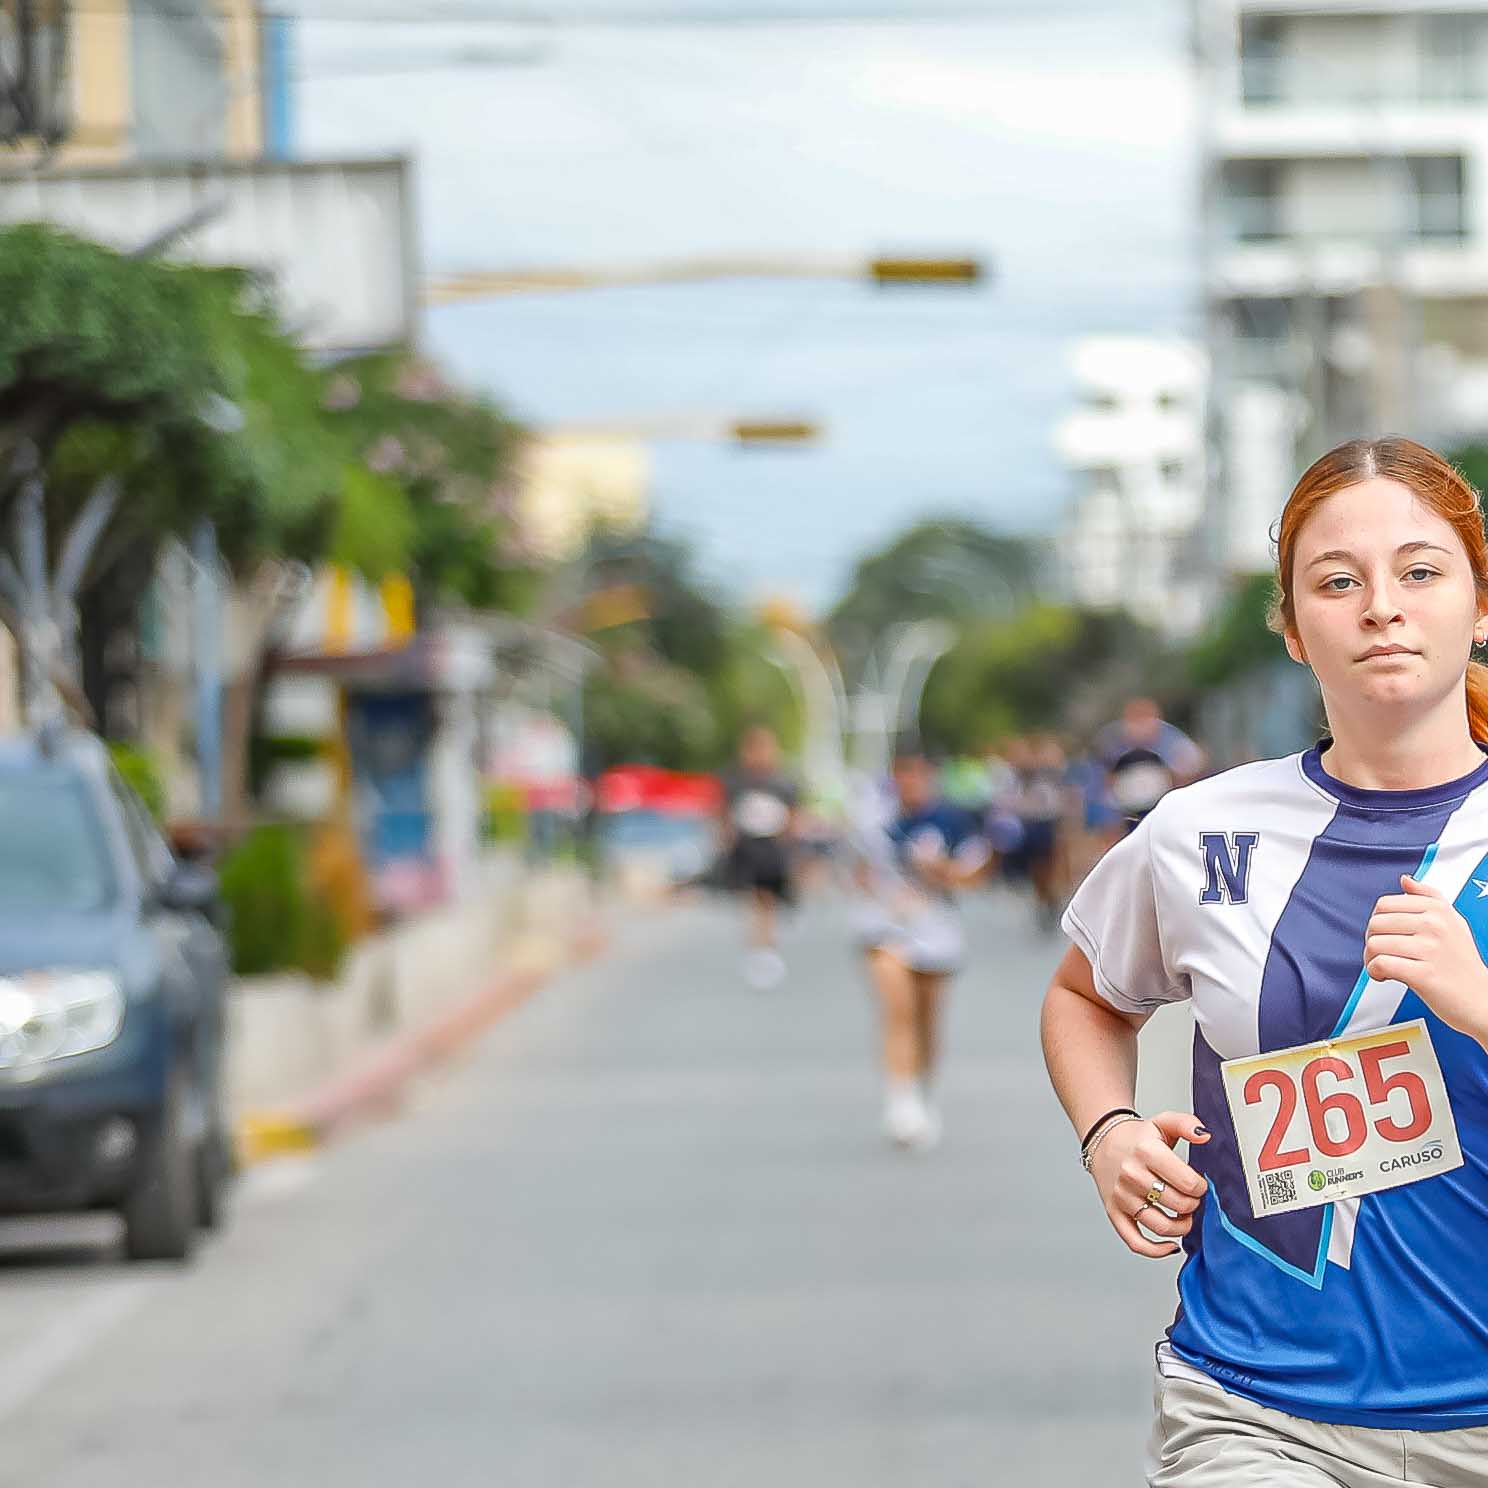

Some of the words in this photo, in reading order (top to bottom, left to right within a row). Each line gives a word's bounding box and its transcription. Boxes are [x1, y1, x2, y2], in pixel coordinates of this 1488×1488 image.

[1199, 831, 1260, 905] N
[1244, 1040, 1433, 1172] 265
[1326, 1167, 1345, 1178] CLUB
[1379, 1147, 1443, 1173] CARUSO
